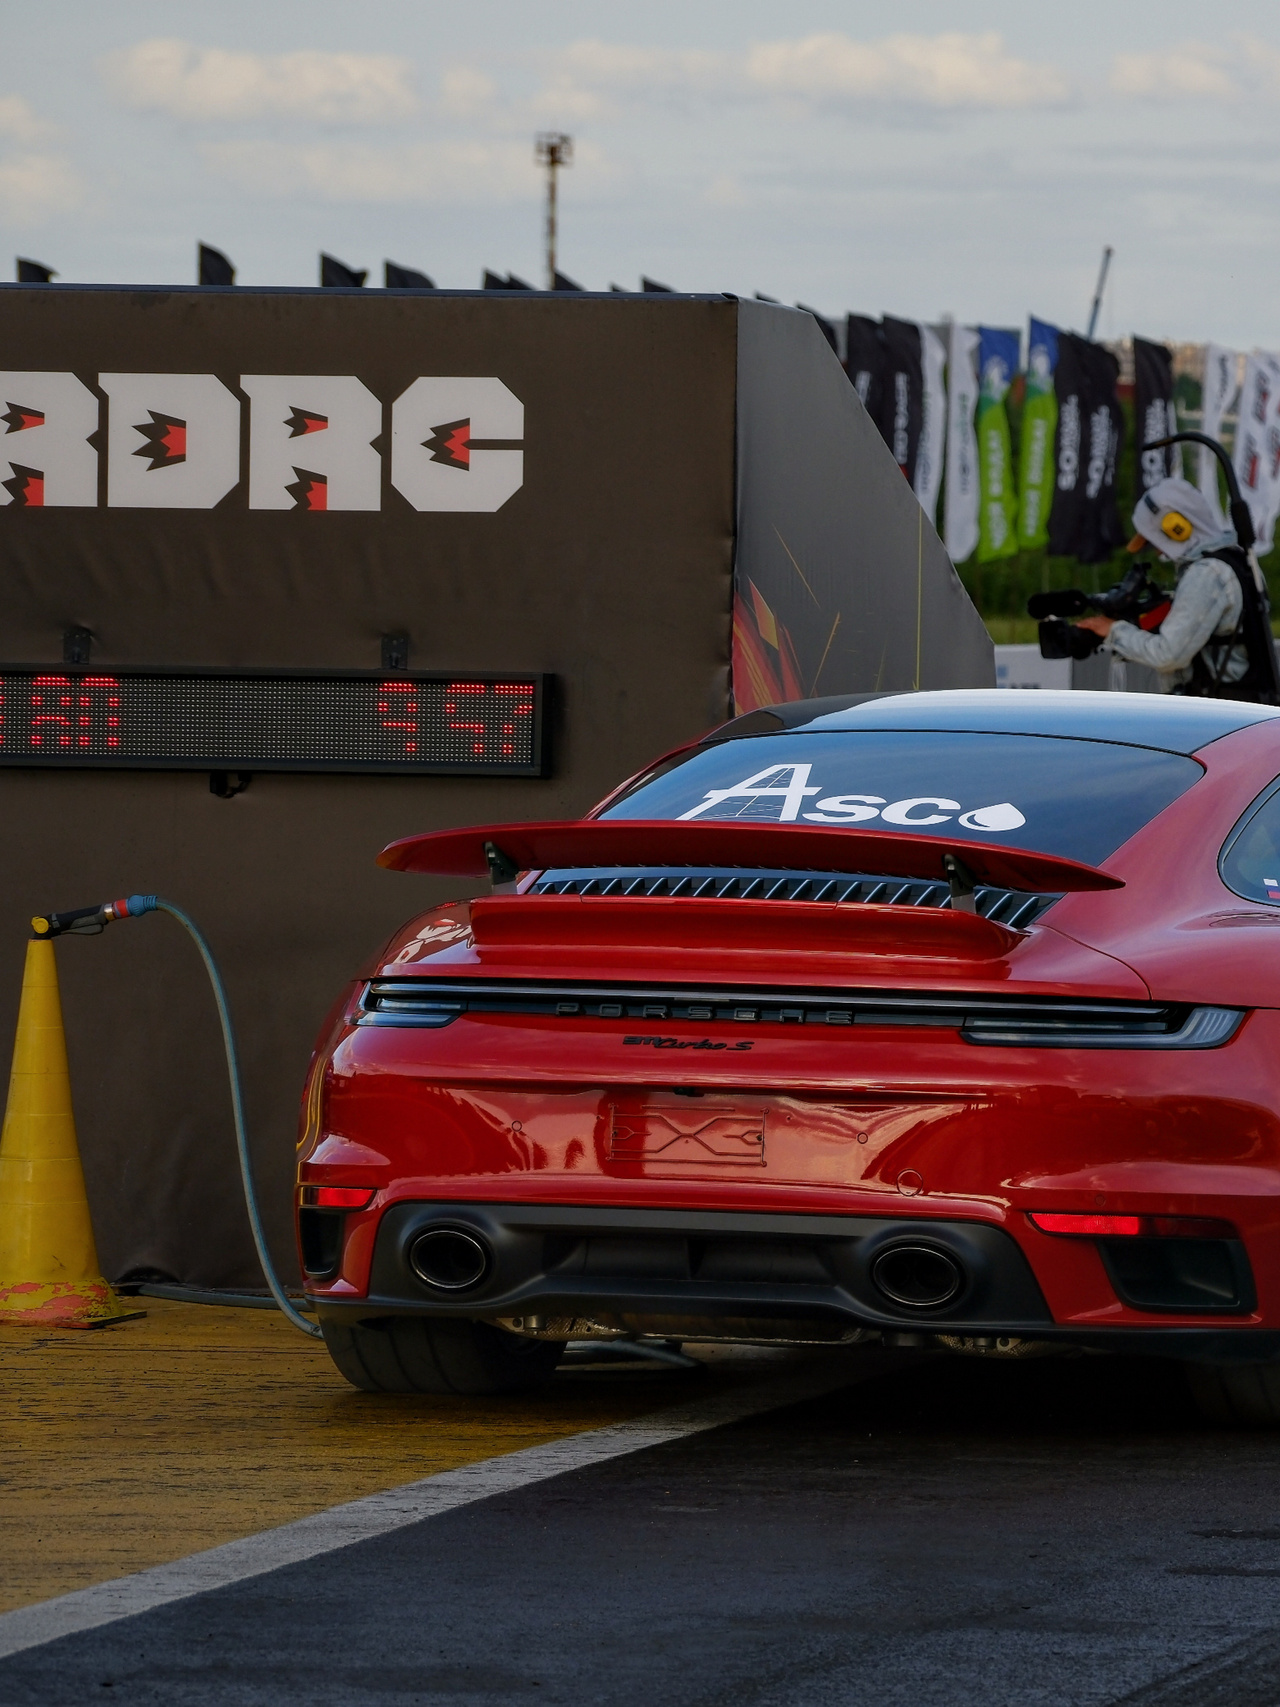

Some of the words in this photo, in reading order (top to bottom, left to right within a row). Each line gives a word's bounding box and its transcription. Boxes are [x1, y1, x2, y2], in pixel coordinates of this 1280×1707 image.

[556, 1003, 853, 1025] PORSCHE
[654, 1037, 727, 1050] Turbo
[726, 1040, 755, 1051] S
